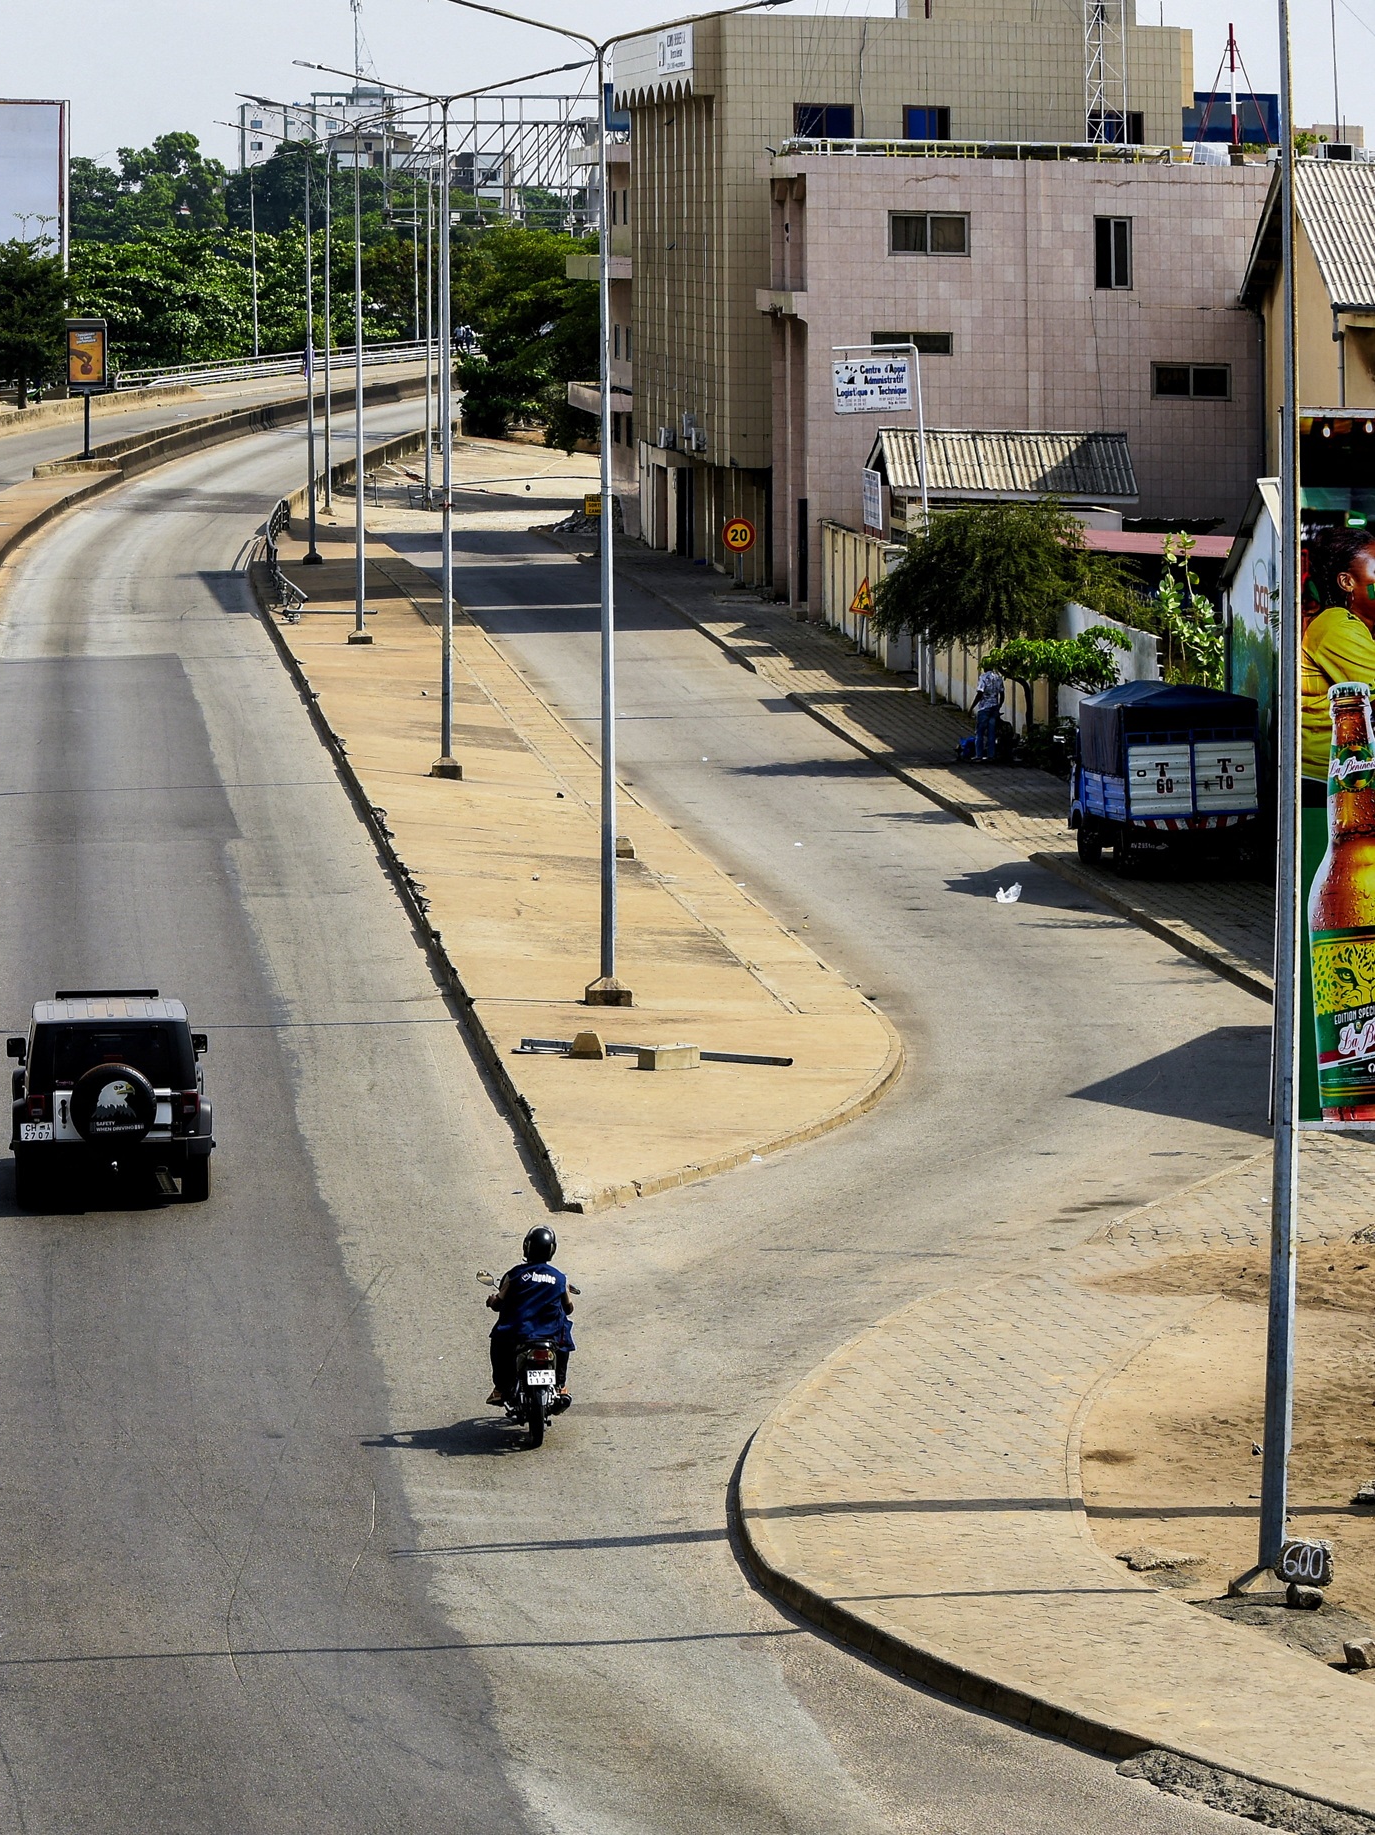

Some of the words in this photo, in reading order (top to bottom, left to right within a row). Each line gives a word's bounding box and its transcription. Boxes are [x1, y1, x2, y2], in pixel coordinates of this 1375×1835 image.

[860, 364, 881, 375] Centre
[885, 363, 906, 376] d'Appui
[864, 374, 904, 385] Administratif
[878, 385, 907, 397] Technique
[730, 528, 748, 542] 20
[1155, 762, 1169, 777] T
[1217, 758, 1232, 773] T
[1329, 760, 1341, 775] La
[1156, 778, 1174, 793] 60
[1215, 775, 1234, 790] 70
[1334, 1010, 1357, 1025] EDITION
[1339, 1027, 1359, 1051] La
[24, 1131, 50, 1140] 2707
[25, 1124, 37, 1132] CH
[1283, 1543, 1324, 1579] 600
